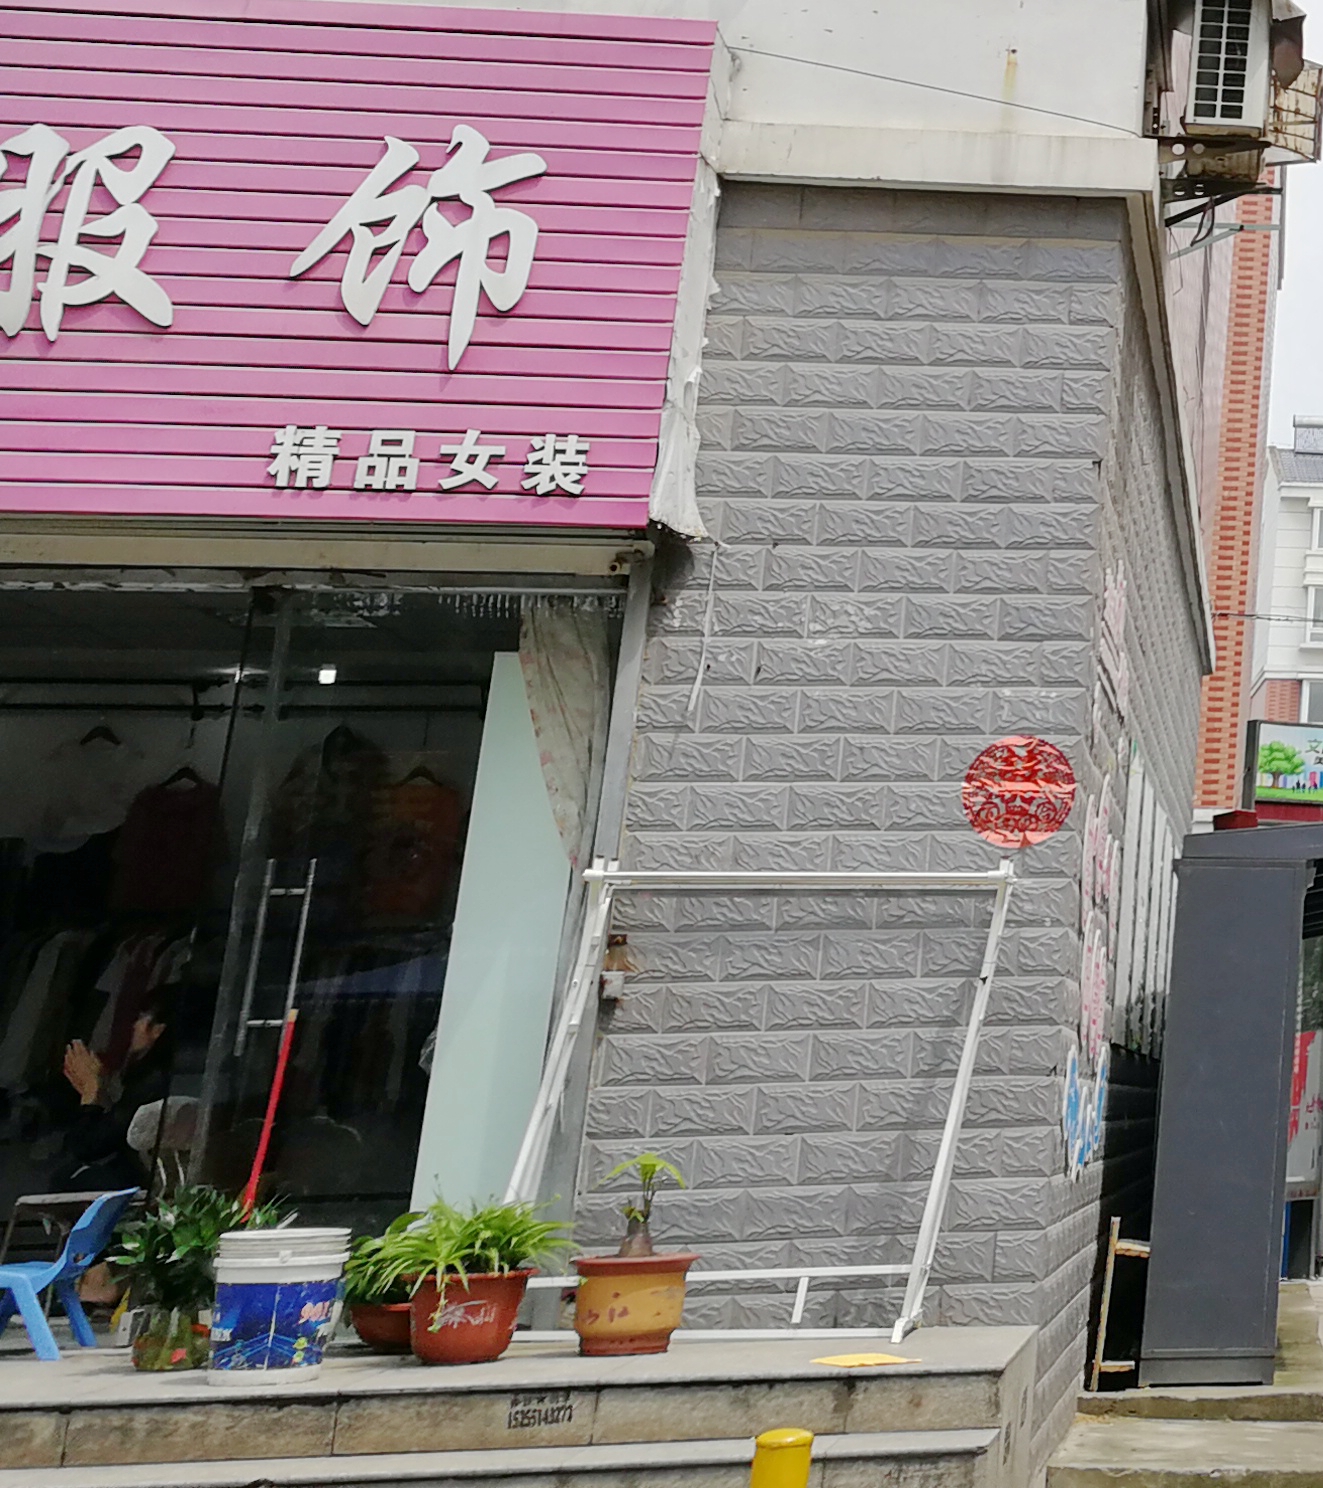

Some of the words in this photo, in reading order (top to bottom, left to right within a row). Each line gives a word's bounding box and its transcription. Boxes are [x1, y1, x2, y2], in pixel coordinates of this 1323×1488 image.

[0, 123, 548, 371] 服饰
[267, 426, 590, 495] 精品女装
